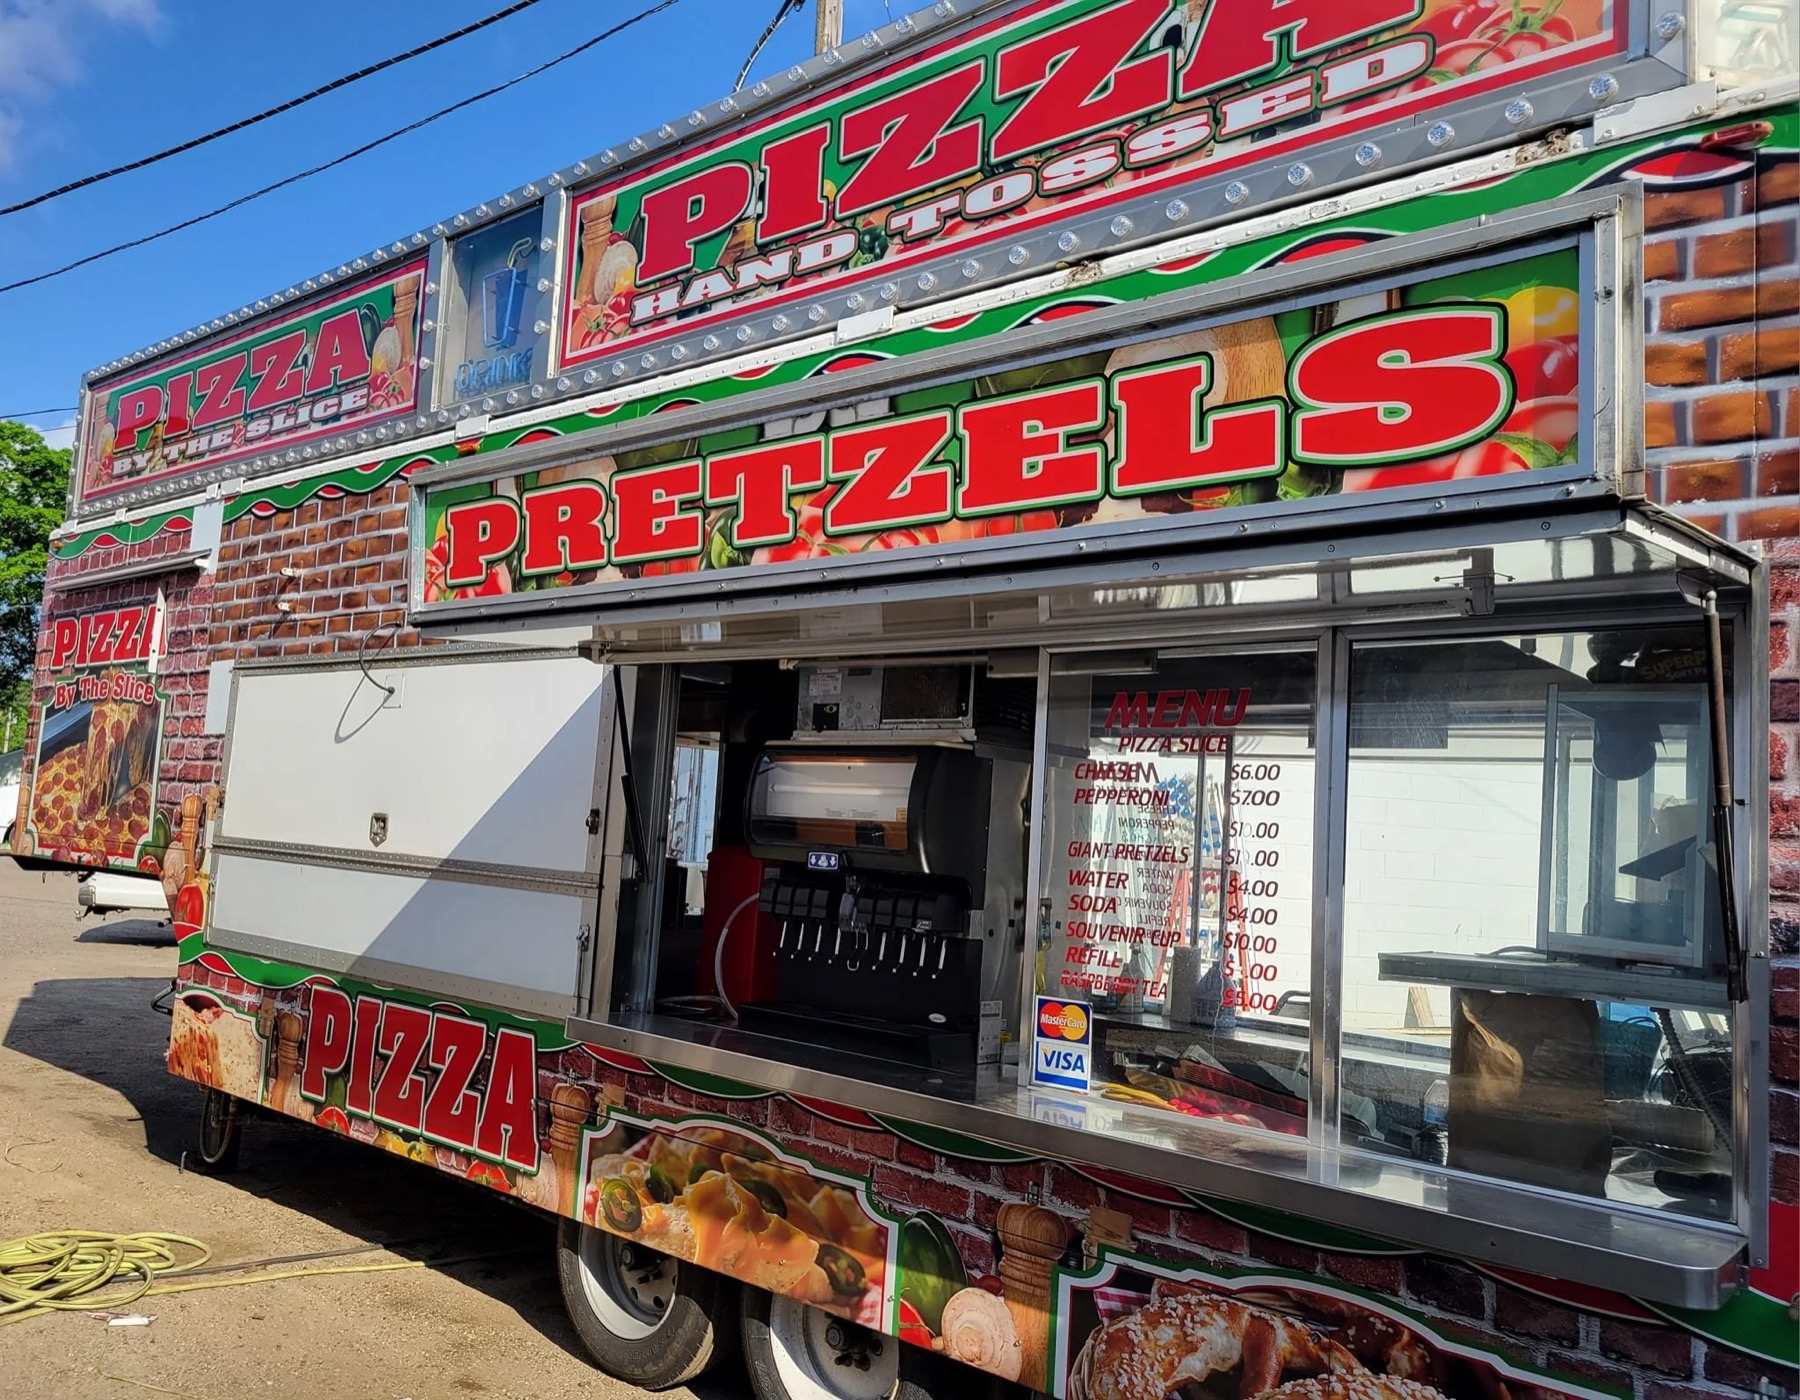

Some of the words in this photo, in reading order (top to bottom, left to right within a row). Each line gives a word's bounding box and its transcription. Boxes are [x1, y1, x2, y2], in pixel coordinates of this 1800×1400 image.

[637, 0, 1423, 286] PIZZA
[630, 229, 858, 326] HAND
[889, 34, 1434, 239] TOSSED
[114, 309, 372, 452] PIZZA
[113, 449, 154, 477] BY
[165, 424, 235, 463] THE
[245, 384, 370, 438] SLICE
[446, 302, 1516, 586] PRETZELS
[55, 683, 76, 709] By
[79, 676, 109, 701] The
[113, 673, 155, 704] Slice
[1104, 687, 1251, 729] MENU
[1118, 734, 1173, 752] PIZZA
[1177, 734, 1230, 752] SLICE
[1232, 763, 1280, 781] $6.00
[1073, 788, 1170, 807] PEPPERONI
[1068, 841, 1112, 859] GIANT
[1114, 843, 1190, 864] PRETZELS
[1068, 869, 1130, 890] WATER
[1226, 878, 1278, 898] $4.00
[1068, 894, 1117, 914] SODA
[1226, 906, 1278, 926] $4.00
[1066, 920, 1146, 944] SOUVENIR
[1151, 930, 1181, 948] CUP
[1224, 931, 1277, 954] $10.00
[1065, 946, 1123, 969] REFILL
[1060, 970, 1140, 995] RASPBERRY
[1142, 981, 1168, 999] TEA
[1222, 988, 1277, 1012] $5.00
[1040, 1013, 1086, 1030] MasterCard
[1042, 1047, 1085, 1073] VISA
[302, 984, 539, 1175] PIZZA
